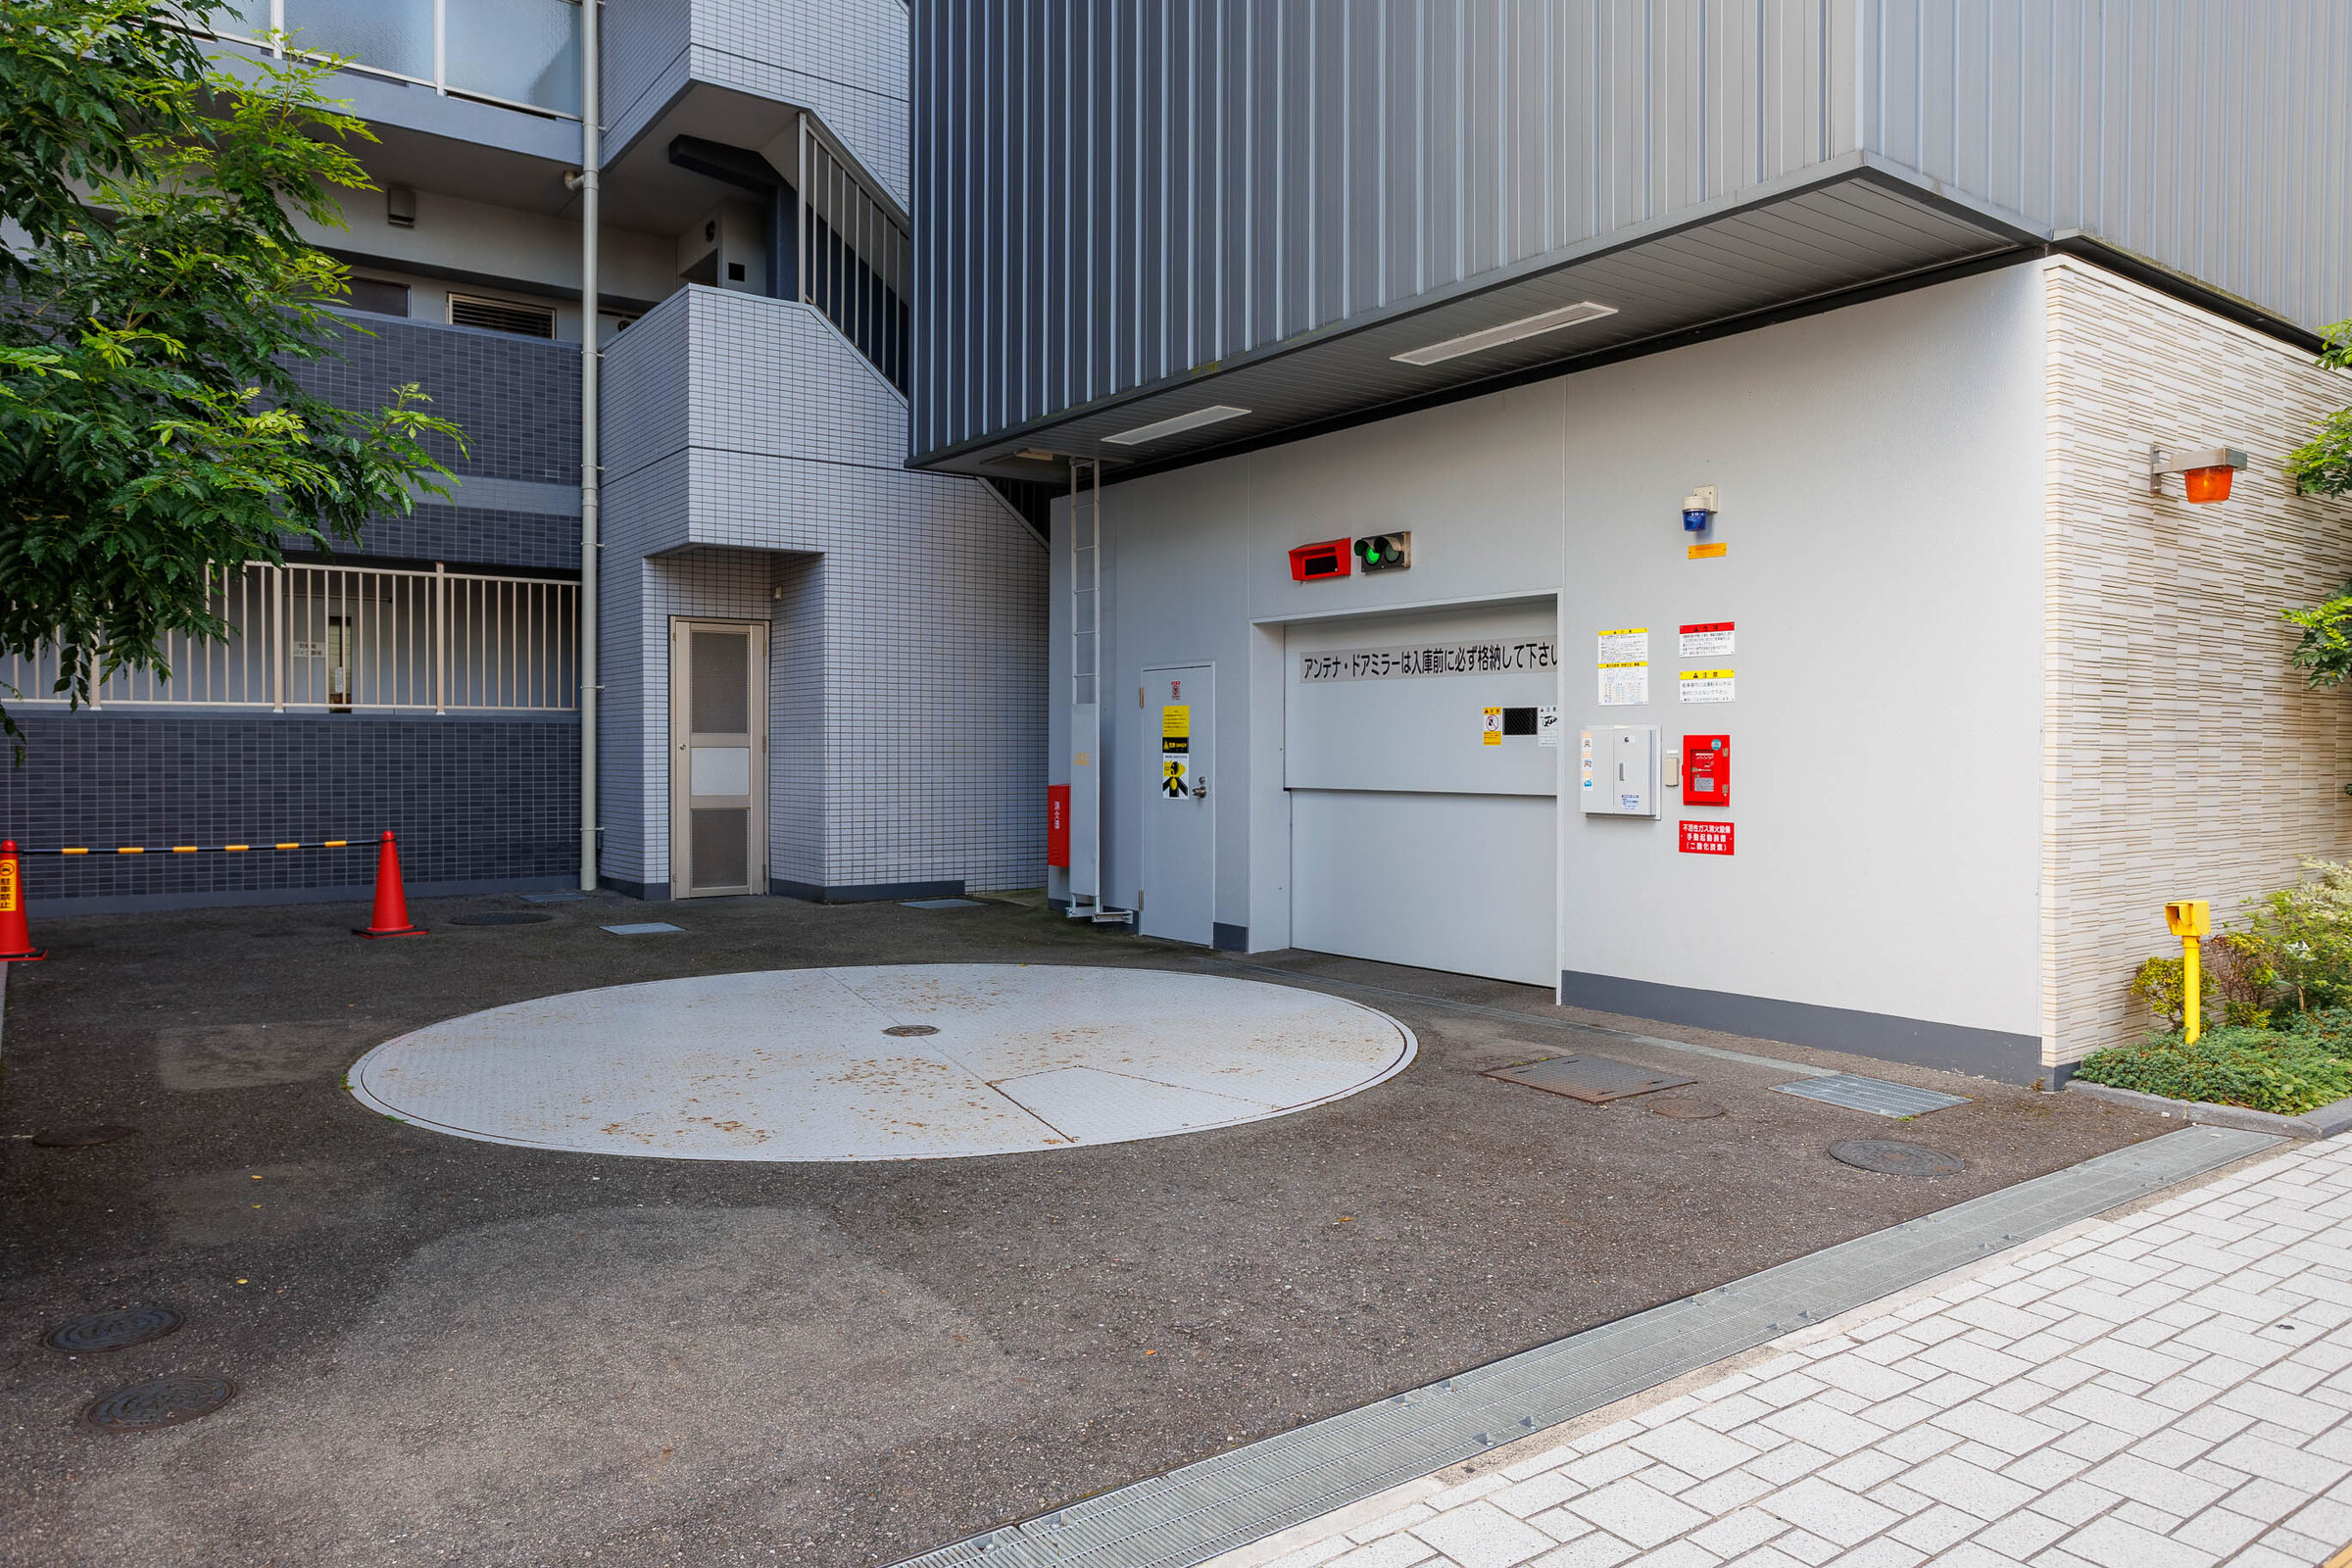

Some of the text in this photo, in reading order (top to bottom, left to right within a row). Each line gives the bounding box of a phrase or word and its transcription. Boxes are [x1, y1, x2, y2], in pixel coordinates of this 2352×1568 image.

[1683, 823, 1731, 834] 不活性ガス消火設備
